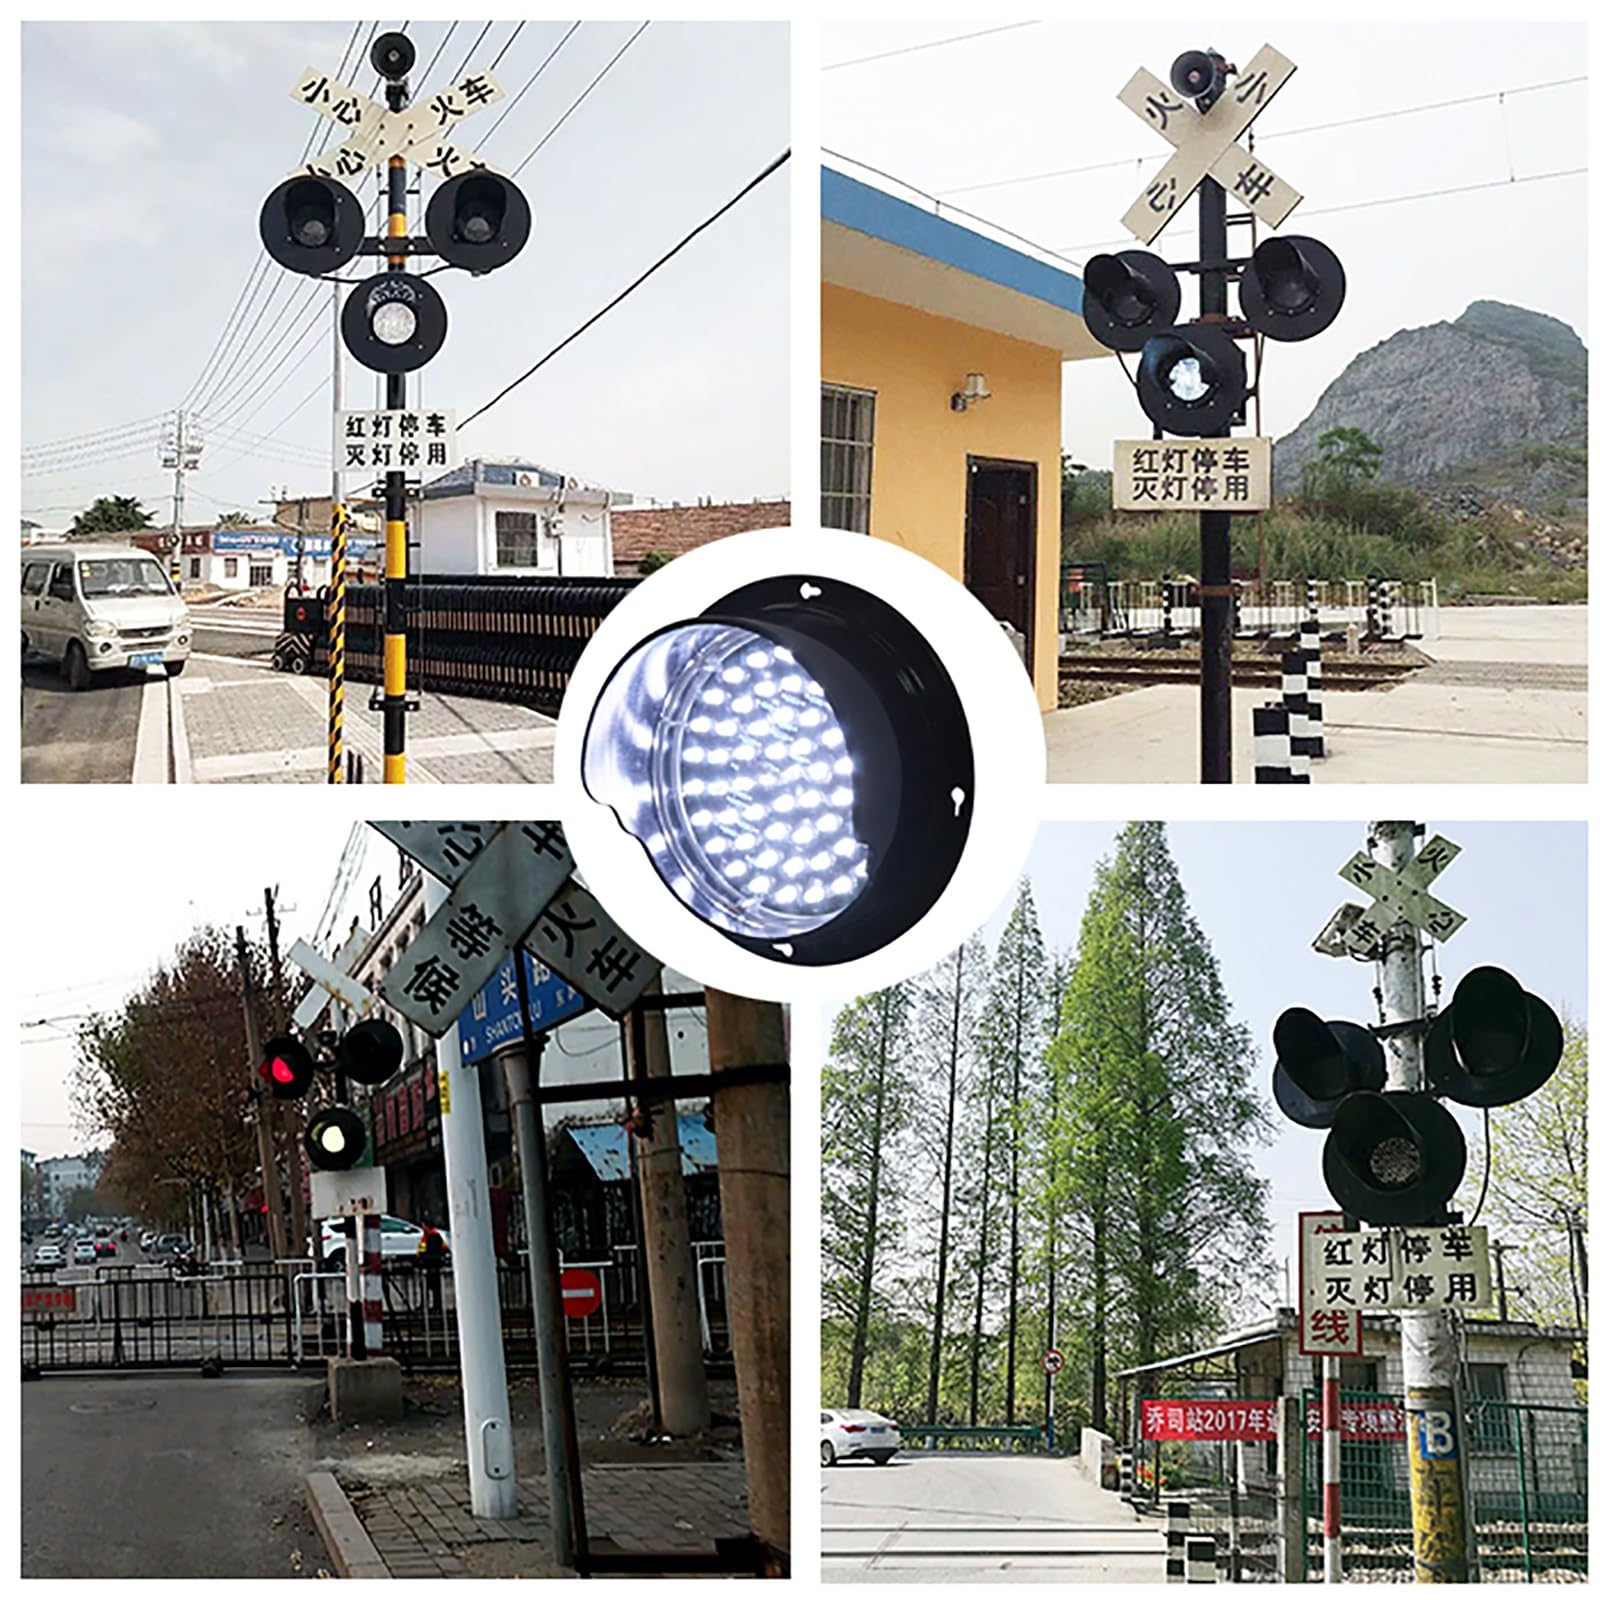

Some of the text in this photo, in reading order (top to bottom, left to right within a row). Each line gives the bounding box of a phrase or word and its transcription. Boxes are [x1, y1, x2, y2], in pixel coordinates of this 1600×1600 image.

[302, 75, 494, 125] 小心 火车
[1146, 71, 1268, 130] 火 小
[426, 147, 485, 177] 火
[1147, 177, 1176, 213] 心
[345, 412, 446, 437] 红灯停车
[345, 441, 446, 466] 灭灯停用
[1132, 446, 1250, 474] 红灯停车
[1132, 475, 1249, 501] 灭灯停用
[537, 902, 641, 993] 火车
[1323, 1231, 1473, 1265] 红灯停车
[1325, 1273, 1477, 1304] 灭灯停用
